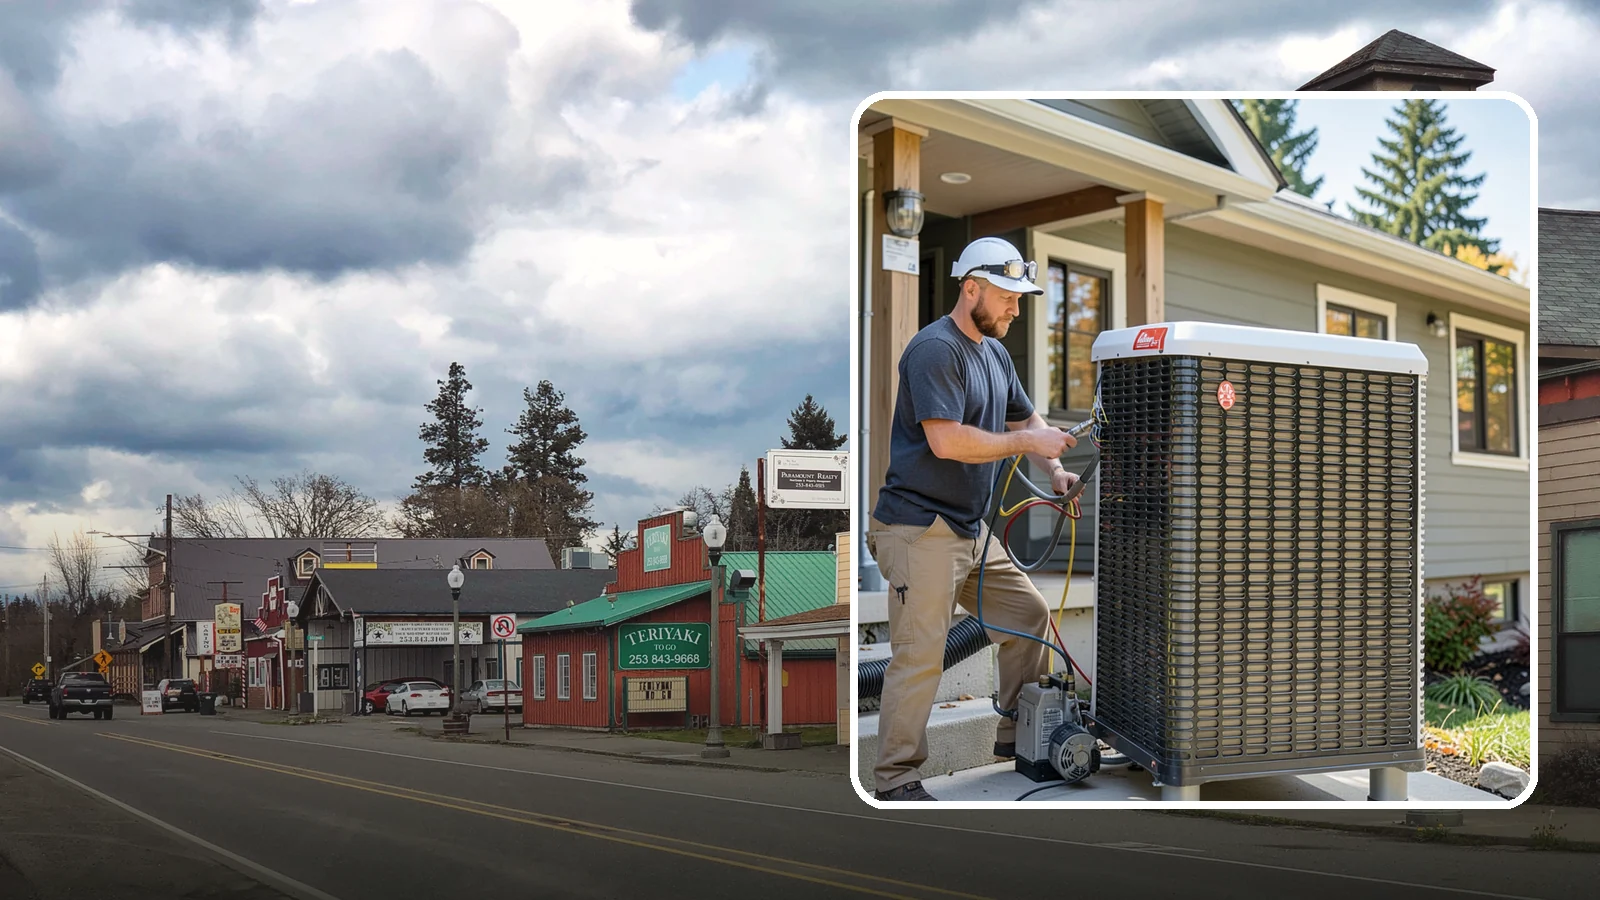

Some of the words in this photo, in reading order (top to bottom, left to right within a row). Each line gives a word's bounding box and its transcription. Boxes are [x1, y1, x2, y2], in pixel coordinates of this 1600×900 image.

[624, 627, 703, 646] TERIYAKI
[629, 655, 648, 664] 253
[652, 654, 700, 664] 843-9668
